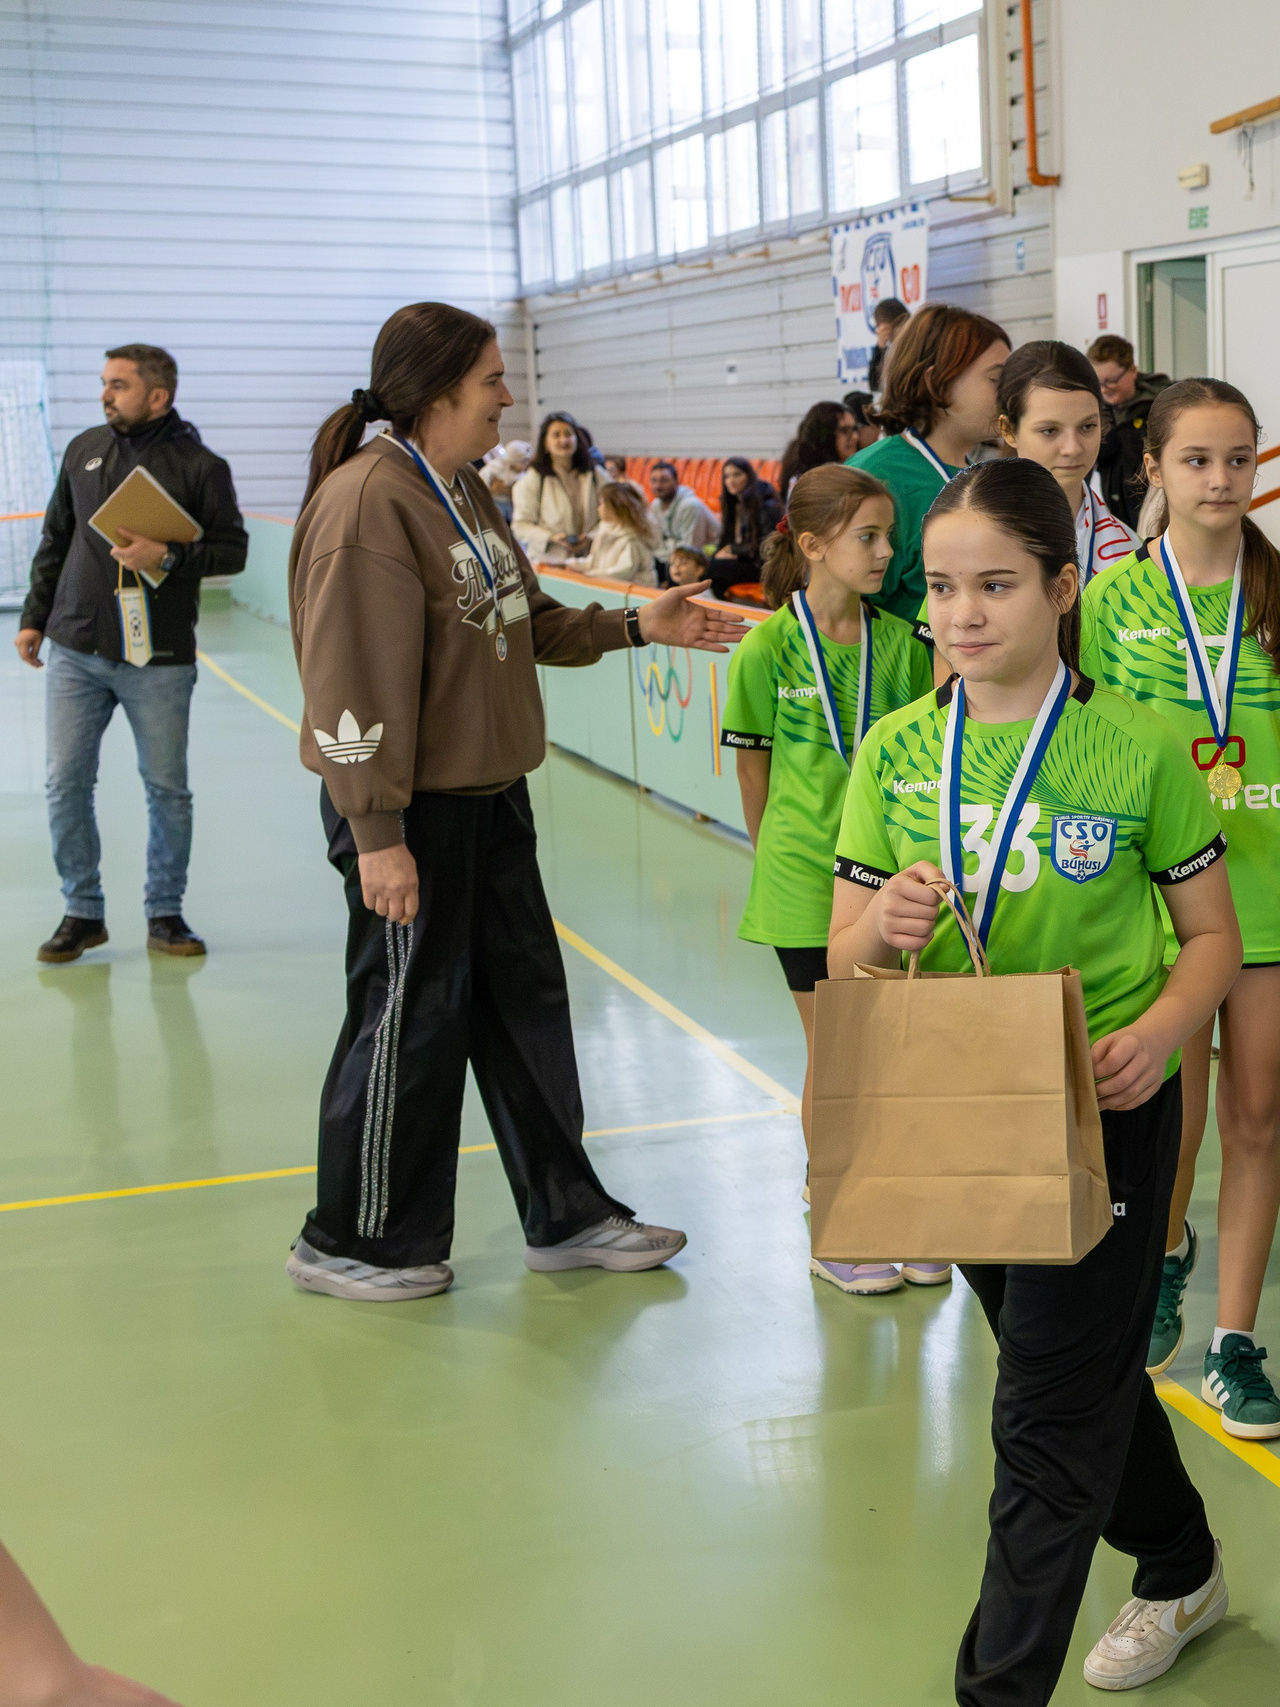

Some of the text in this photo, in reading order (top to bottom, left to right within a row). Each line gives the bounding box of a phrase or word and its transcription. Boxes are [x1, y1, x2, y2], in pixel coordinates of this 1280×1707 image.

[1118, 625, 1171, 643] Kempa
[1060, 821, 1108, 842] CSO
[1168, 848, 1217, 880] Kempa
[850, 865, 889, 887] Kem
